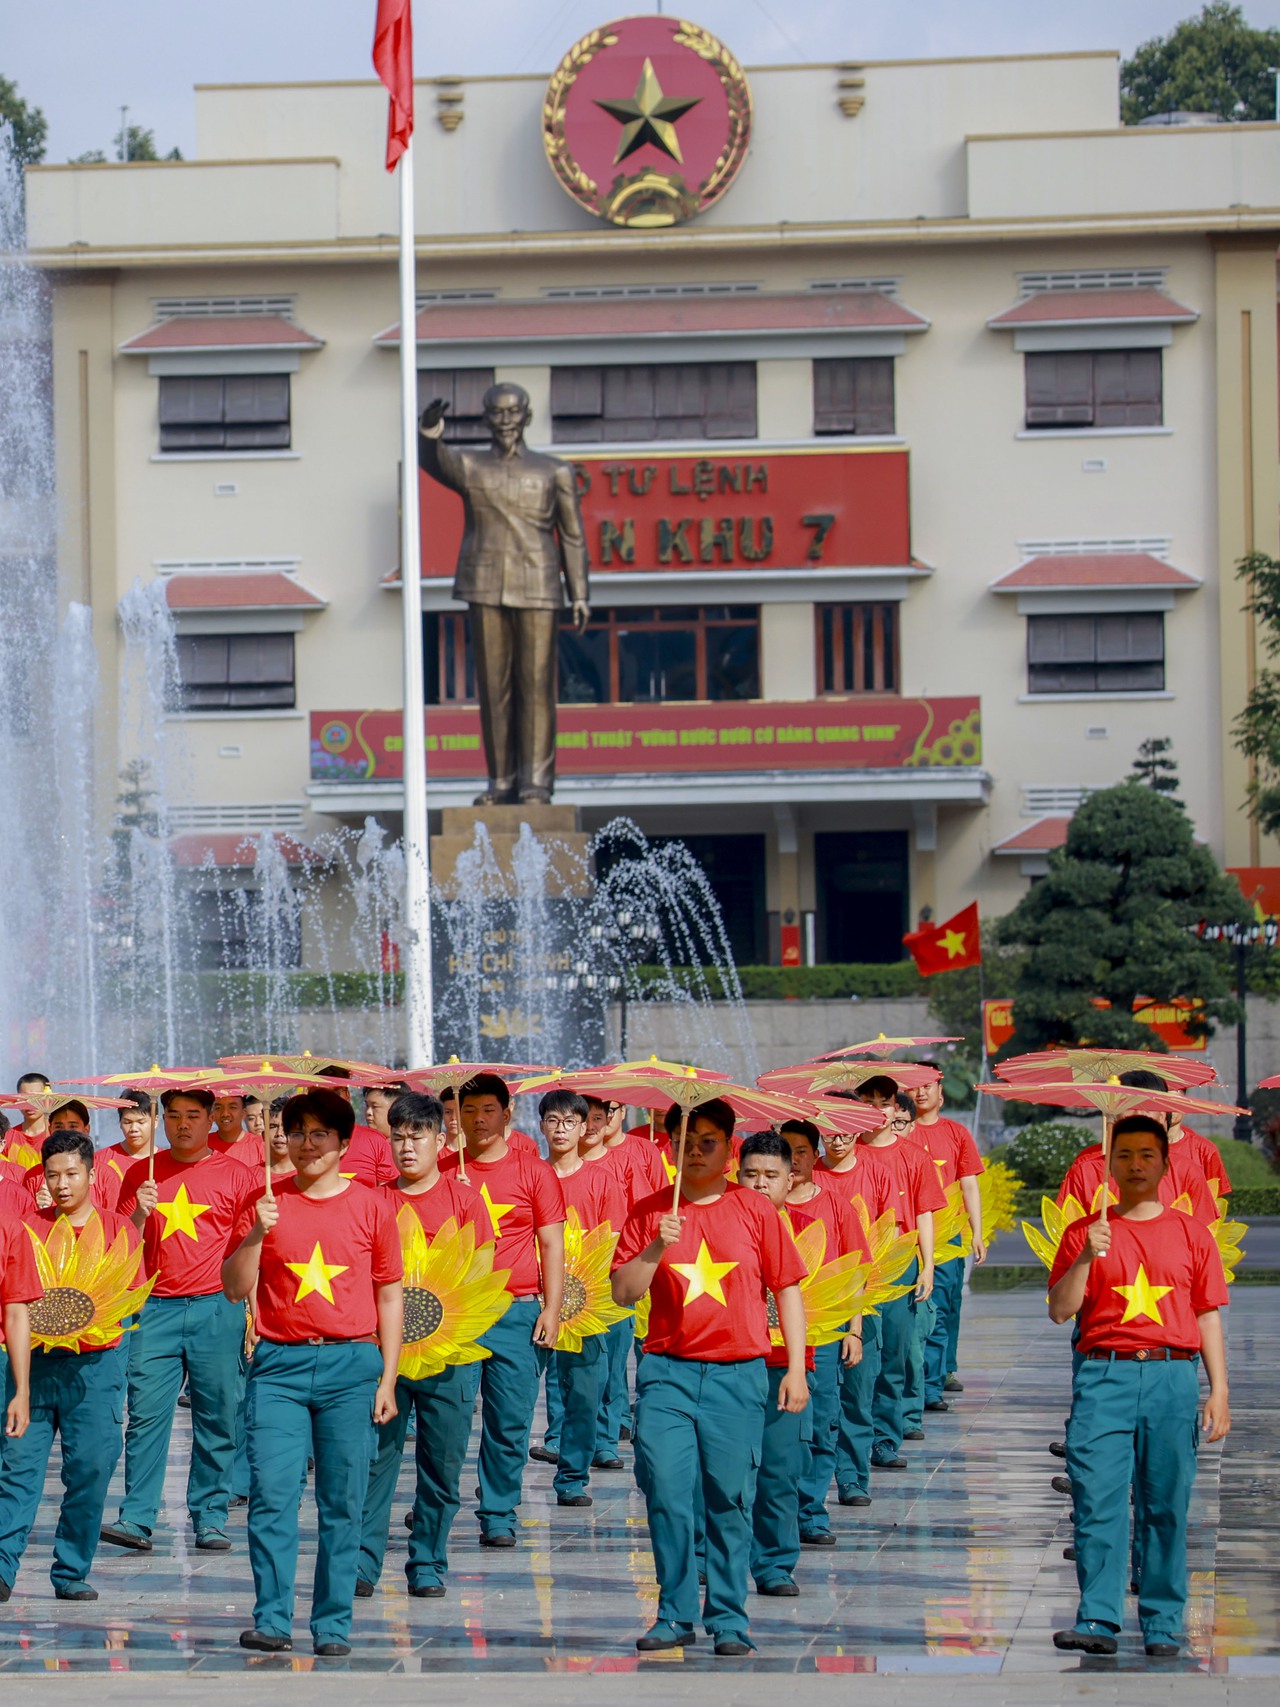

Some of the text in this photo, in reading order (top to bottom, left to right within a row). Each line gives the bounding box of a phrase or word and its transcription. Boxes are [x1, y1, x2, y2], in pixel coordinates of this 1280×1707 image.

[602, 464, 657, 496] TƯ
[669, 459, 769, 501] LỆNH
[658, 516, 775, 564] KHU
[802, 514, 837, 559] 7
